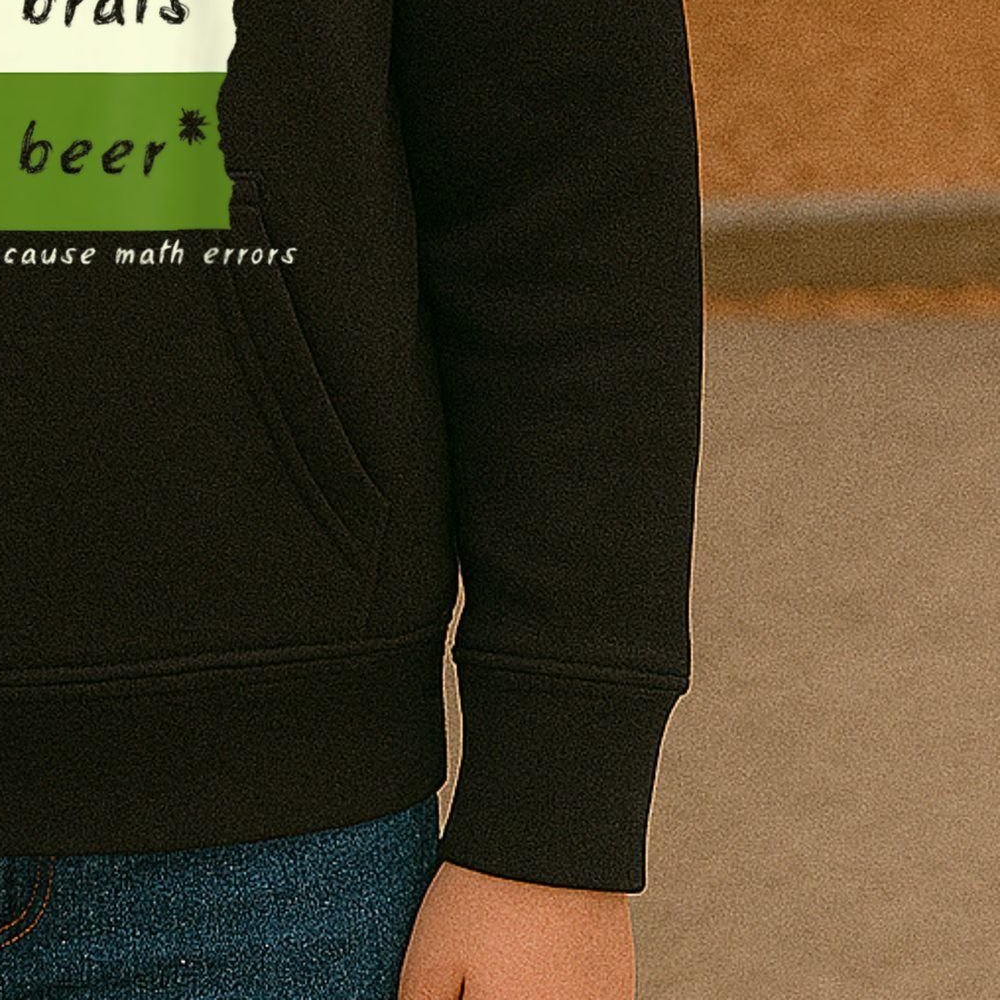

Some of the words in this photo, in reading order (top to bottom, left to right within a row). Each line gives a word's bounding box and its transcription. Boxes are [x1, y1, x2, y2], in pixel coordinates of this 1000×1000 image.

[3, 246, 97, 266] cause
[114, 239, 185, 266] math
[203, 245, 300, 266] errors
